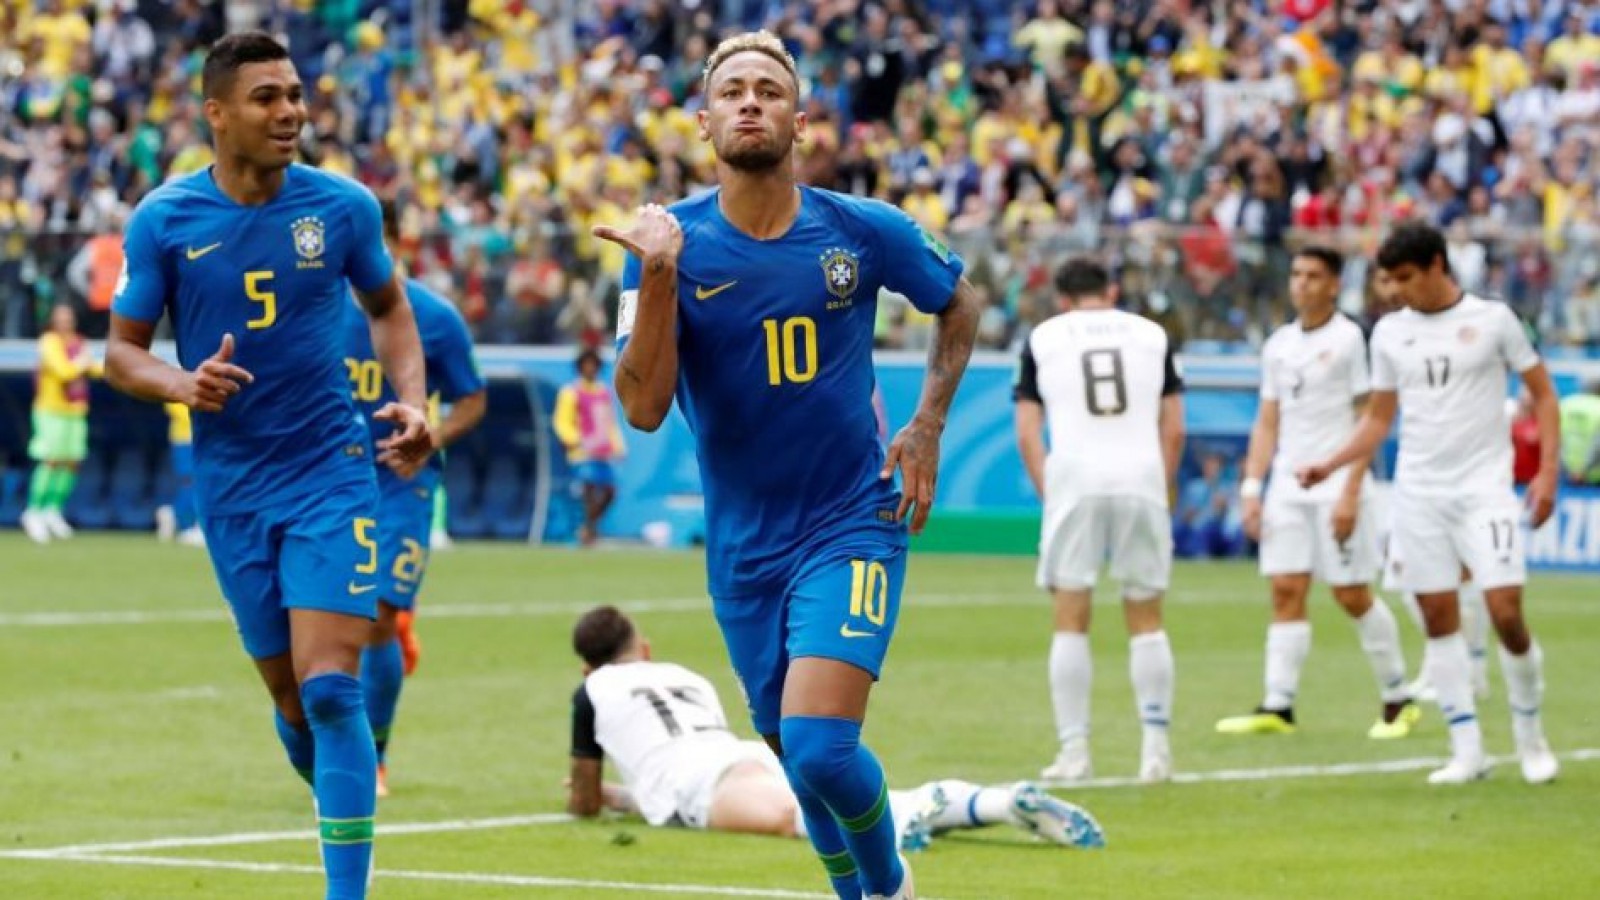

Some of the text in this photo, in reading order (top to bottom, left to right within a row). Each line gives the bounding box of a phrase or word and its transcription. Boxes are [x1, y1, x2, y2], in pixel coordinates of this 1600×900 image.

[243, 270, 277, 330] 5
[763, 316, 817, 386] 10
[1424, 355, 1450, 388] 17
[343, 358, 381, 402] 20
[1081, 347, 1127, 417] 8
[353, 517, 377, 574] 5
[1488, 518, 1513, 551] 17
[849, 559, 888, 627] 10
[630, 685, 728, 738] 15
